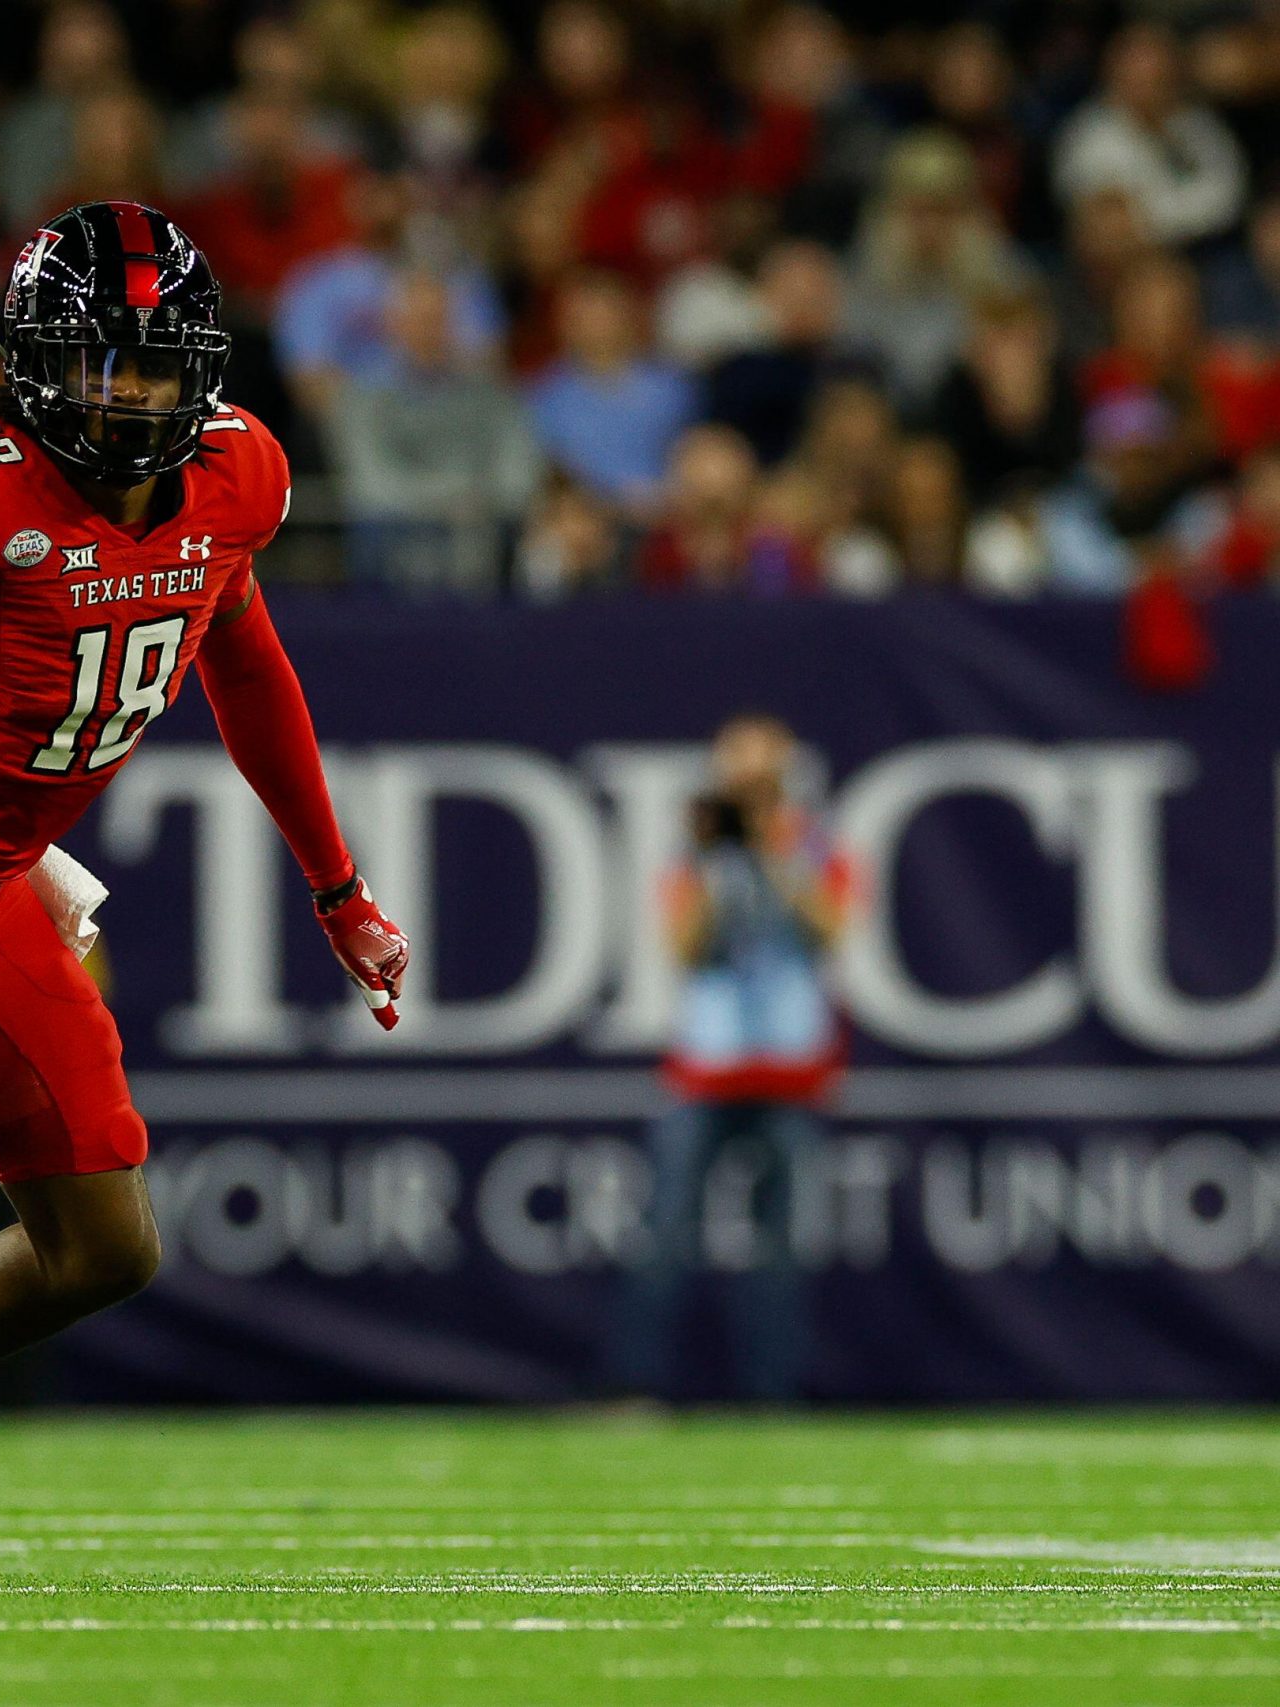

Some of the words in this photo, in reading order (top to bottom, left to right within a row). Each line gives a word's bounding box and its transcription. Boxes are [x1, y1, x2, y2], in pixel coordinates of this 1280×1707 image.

[12, 538, 45, 556] TEXAS
[60, 543, 100, 574] XII
[70, 574, 144, 608] TEXAS
[150, 566, 206, 596] TECH
[28, 613, 188, 774] 18
